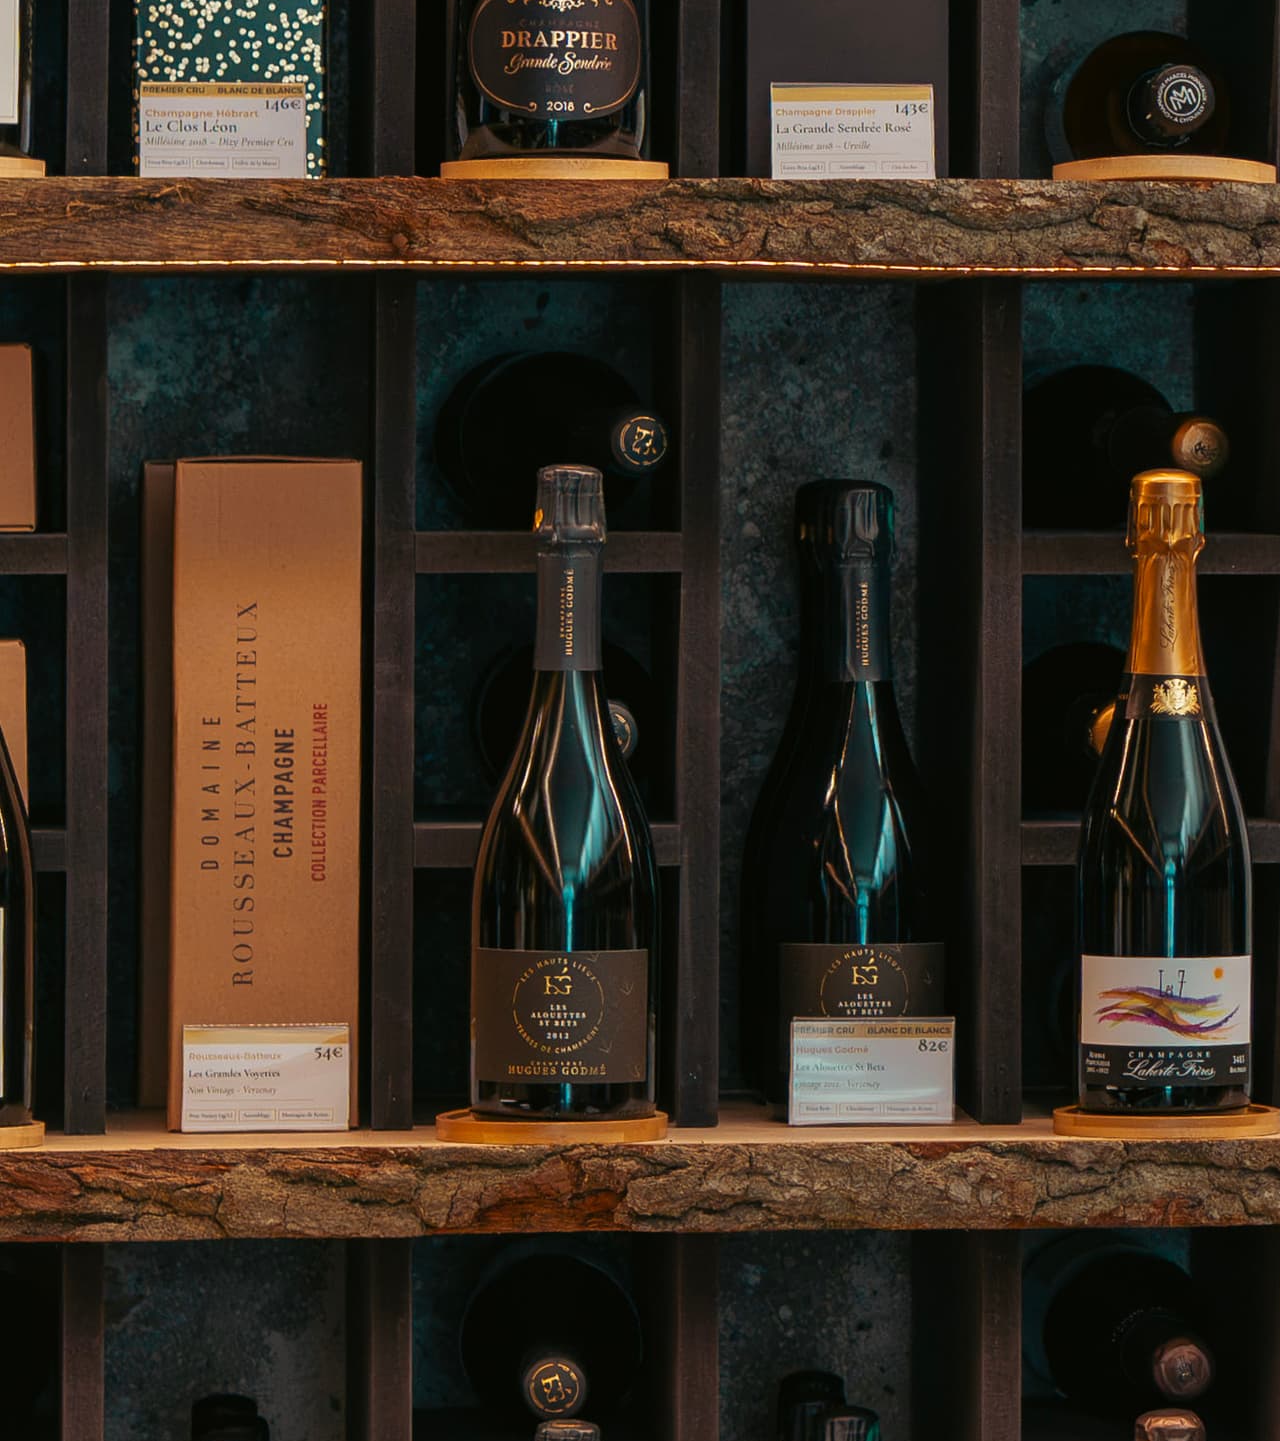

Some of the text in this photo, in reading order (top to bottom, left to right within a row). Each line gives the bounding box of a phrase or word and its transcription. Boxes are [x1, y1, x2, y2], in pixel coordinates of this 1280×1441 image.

[501, 30, 617, 50] DRAPPIER
[265, 98, 301, 112] 146€
[546, 102, 575, 111] 2018
[895, 103, 928, 116] 143€
[145, 110, 213, 119] Champagne
[776, 108, 832, 116] Champagne
[146, 120, 238, 133] Le Clos Léon
[777, 123, 834, 134] La Grande
[201, 716, 221, 871] DOMAINE
[232, 600, 259, 987] ROUSSEAUX-BATTEUX
[273, 728, 295, 858] CHAMPAGNE
[312, 702, 328, 882] COLLECTION PARCELLAIRE
[918, 1039, 948, 1052] 82€
[314, 1047, 343, 1060] 54€
[508, 1065, 557, 1075] HUGUES
